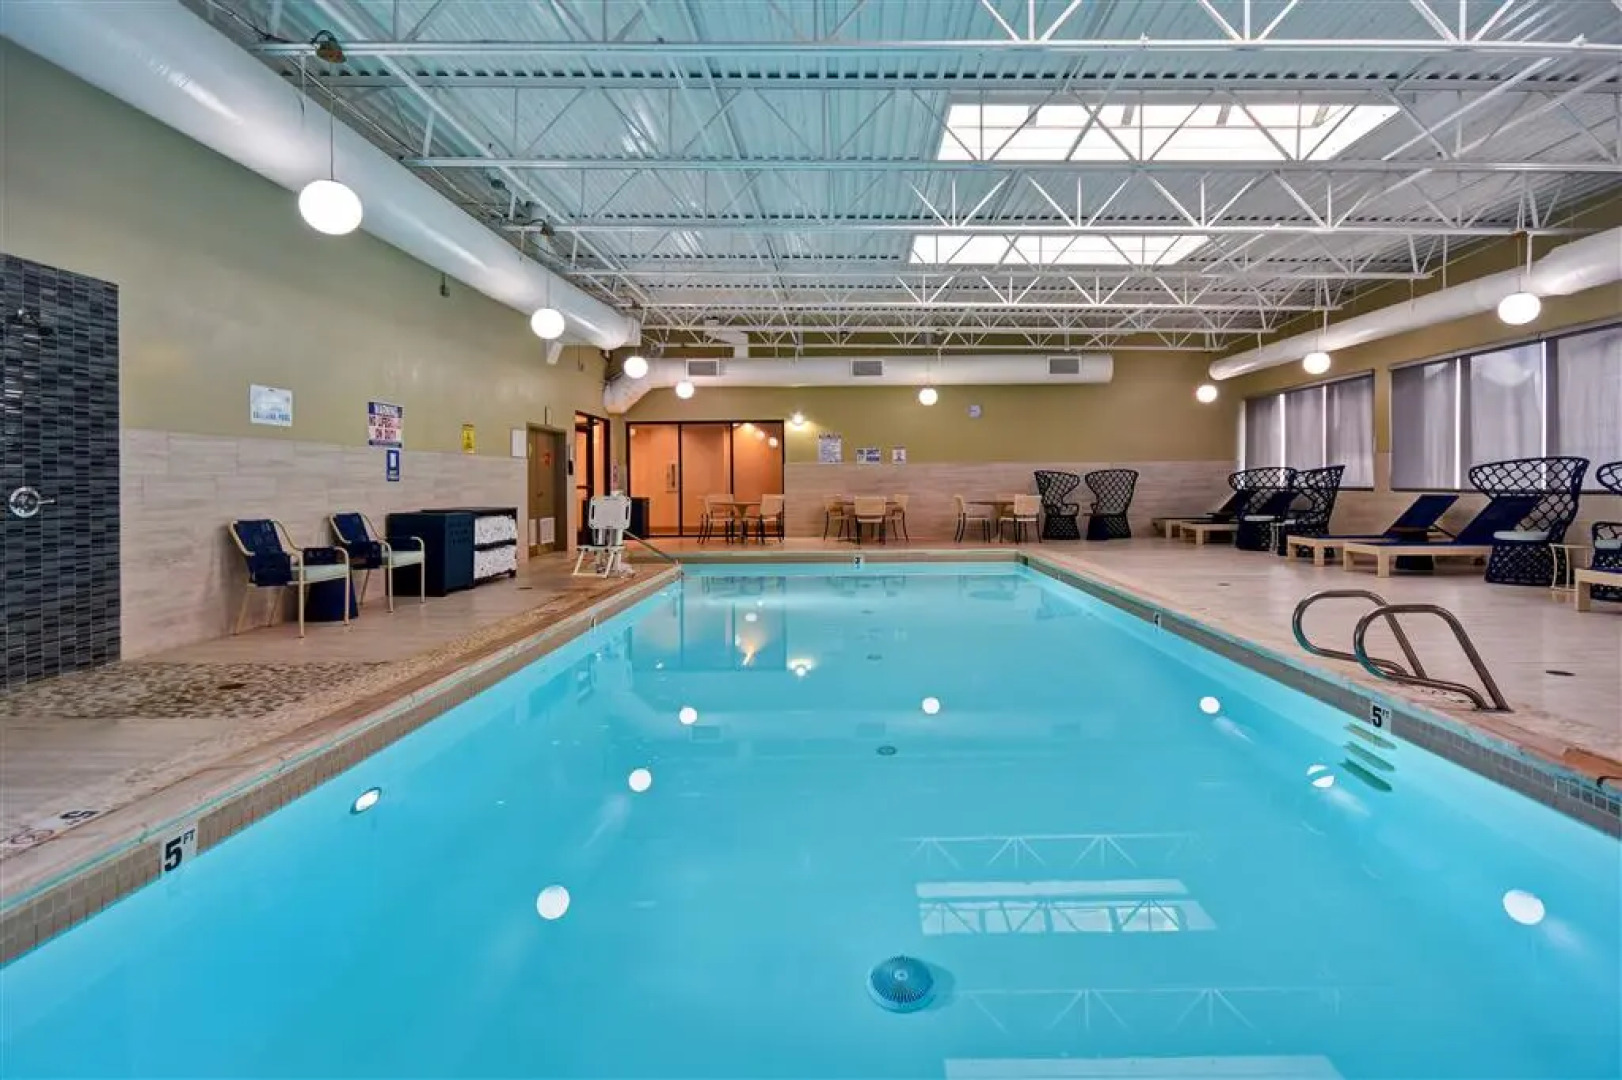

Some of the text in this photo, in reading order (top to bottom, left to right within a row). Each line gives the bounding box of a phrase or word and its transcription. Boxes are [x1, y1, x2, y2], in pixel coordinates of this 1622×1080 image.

[1372, 705, 1382, 728] 5
[164, 829, 196, 872] 5 FT
